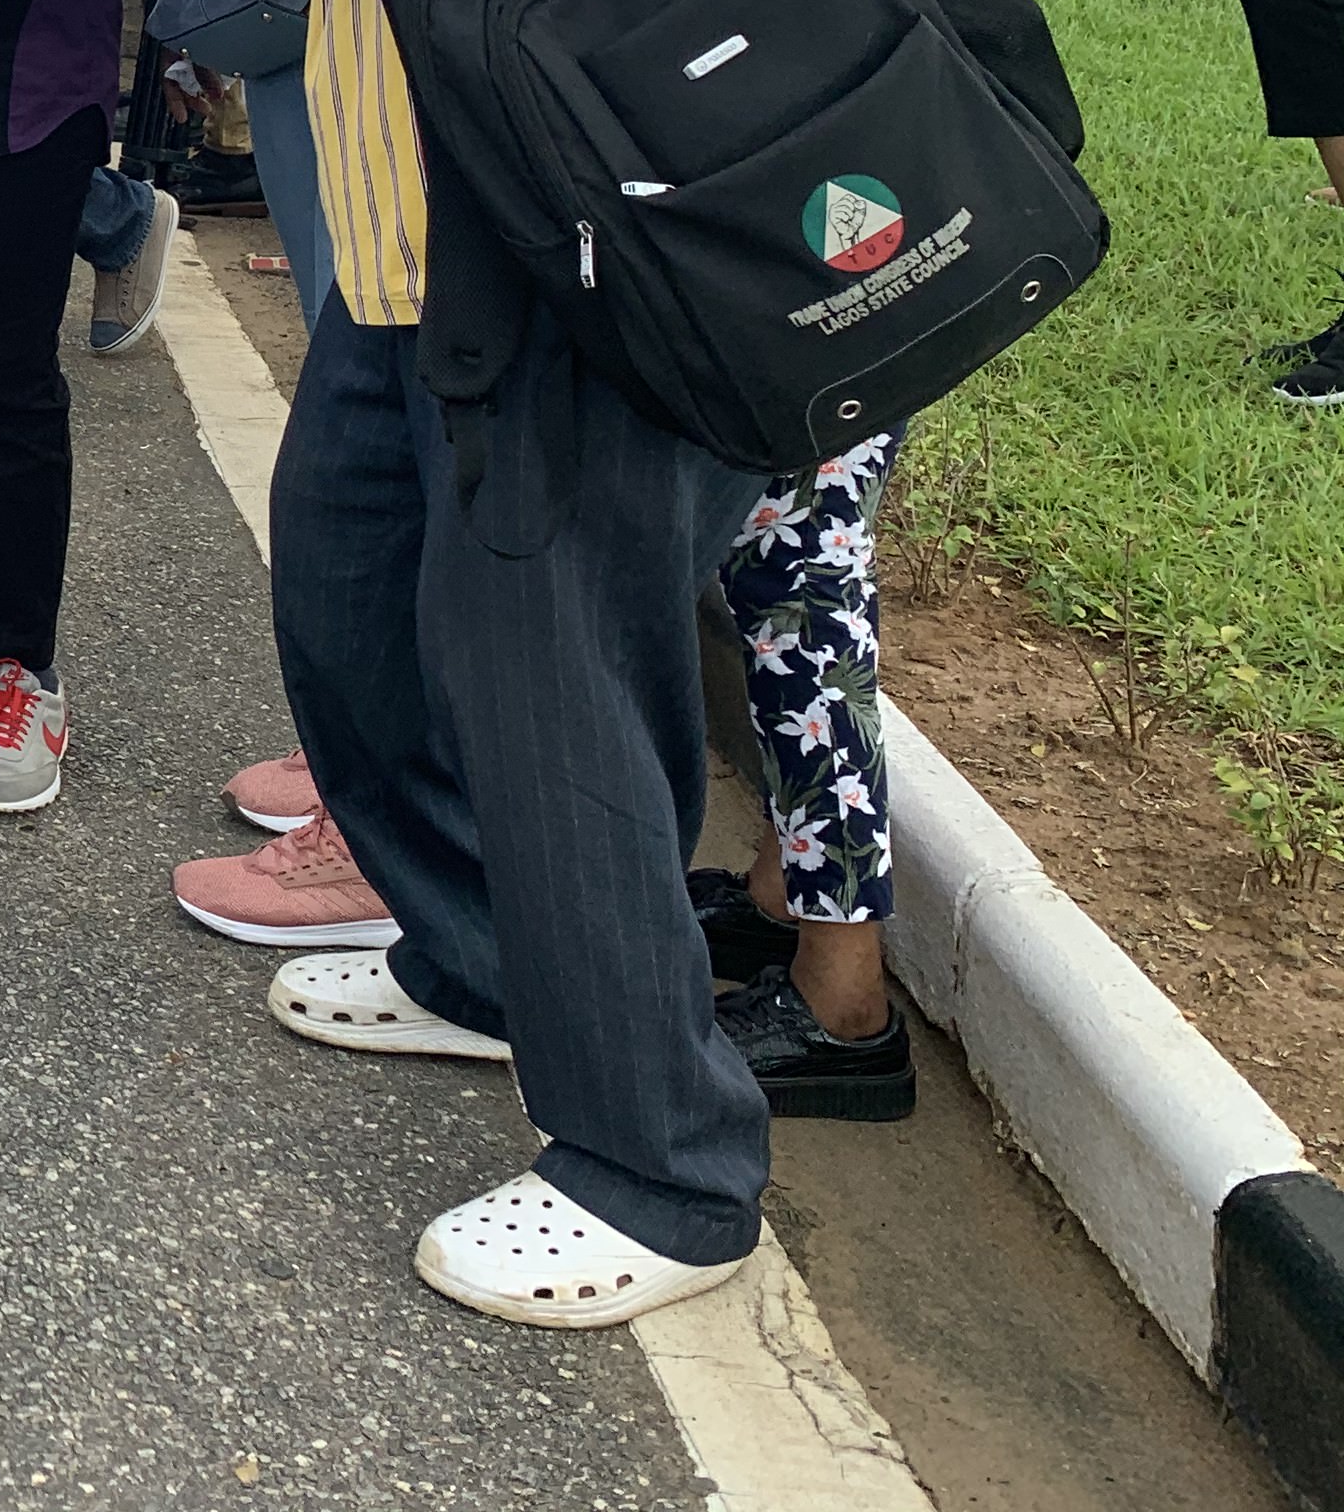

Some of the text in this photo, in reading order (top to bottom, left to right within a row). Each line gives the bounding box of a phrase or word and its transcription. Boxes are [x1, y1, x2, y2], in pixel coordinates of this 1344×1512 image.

[787, 299, 831, 328] TRADE
[825, 283, 867, 314] UNION
[862, 248, 923, 294] CONGRESS
[918, 237, 937, 259] OF
[818, 238, 971, 336] LAGOS STATE COUNCIL
